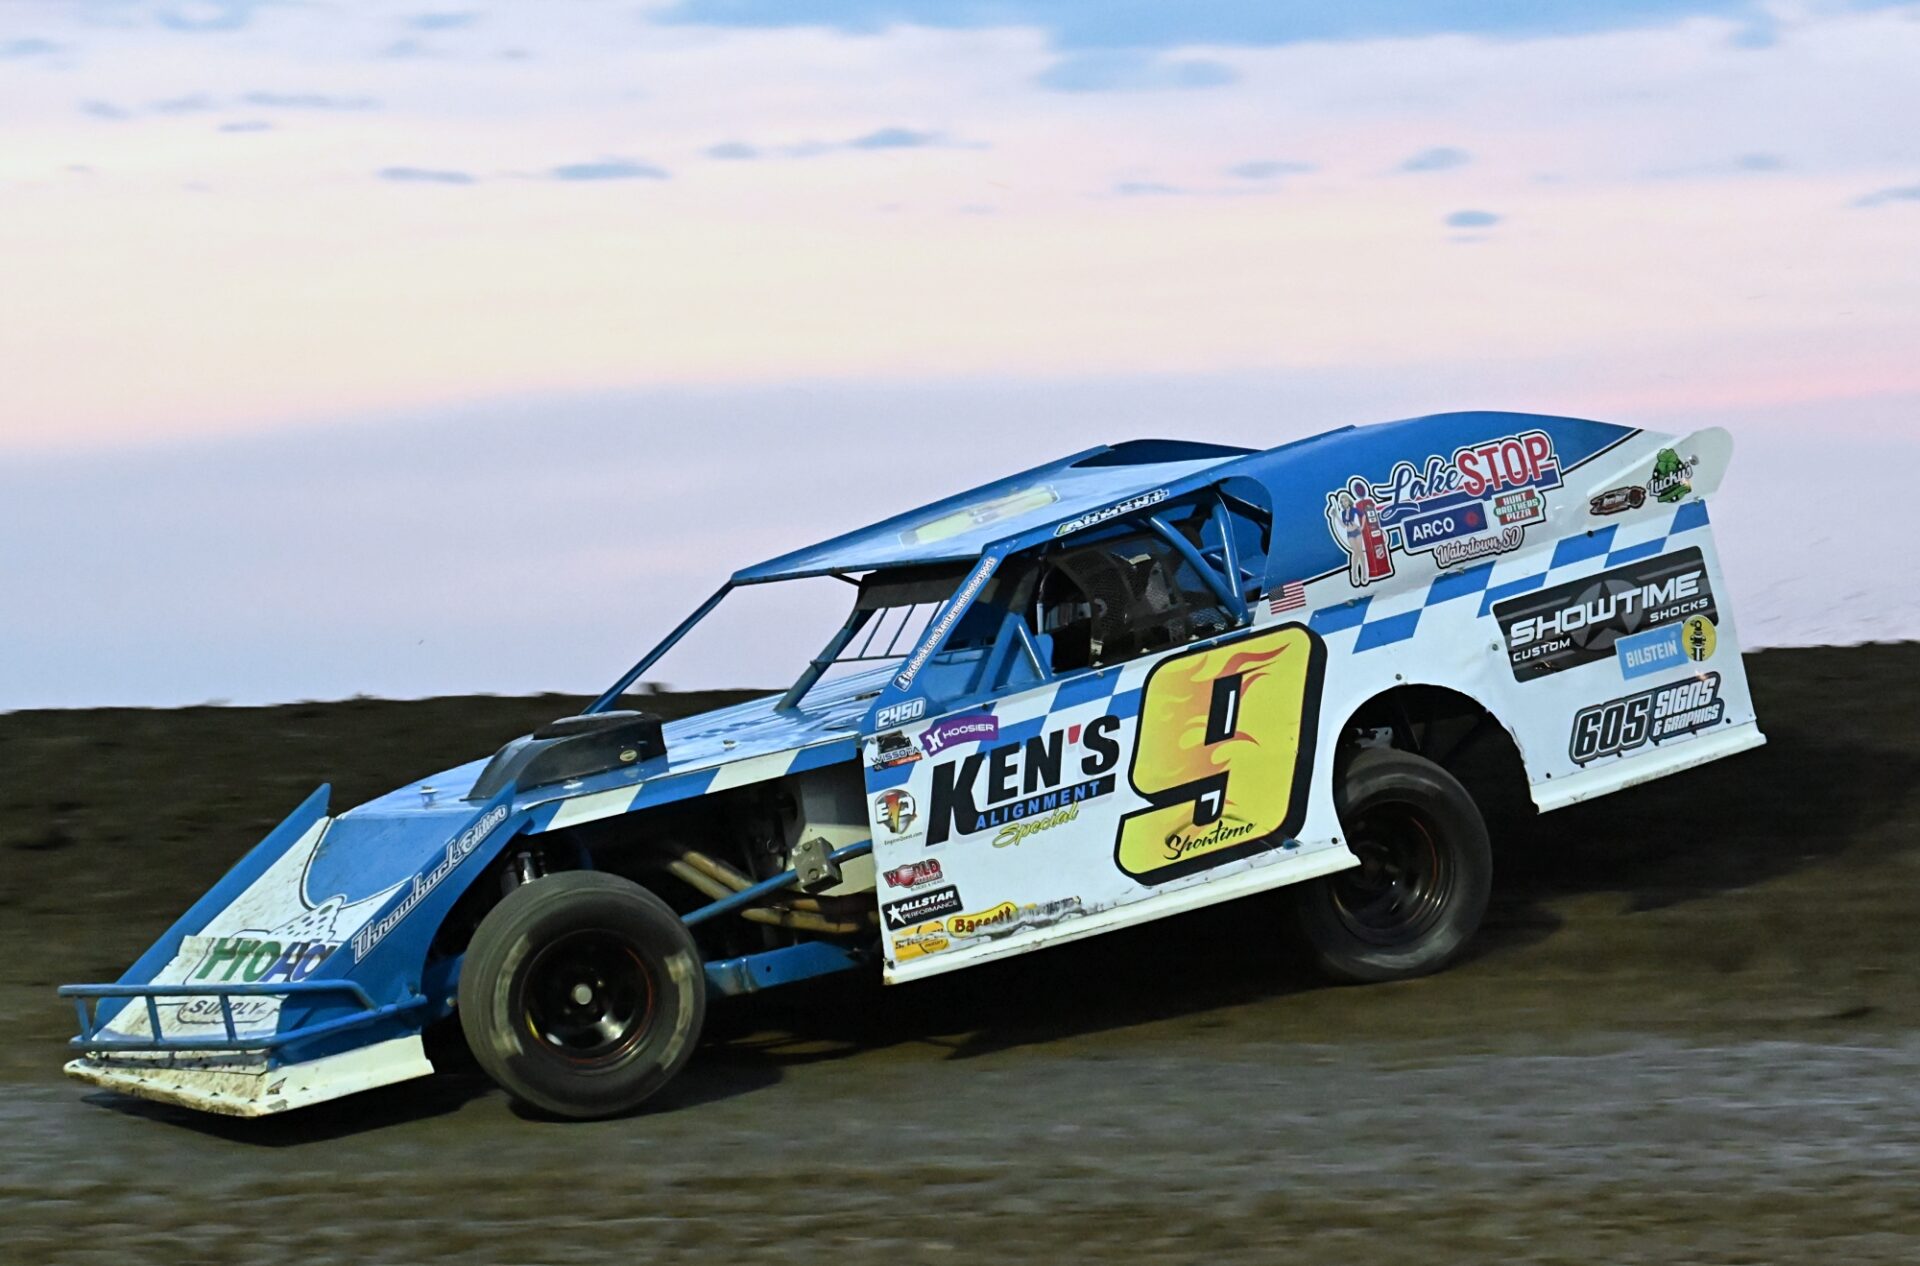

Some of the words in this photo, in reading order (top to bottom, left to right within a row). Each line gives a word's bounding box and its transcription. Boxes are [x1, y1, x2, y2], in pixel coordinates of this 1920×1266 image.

[1375, 461, 1463, 520] Lake
[1457, 435, 1549, 497] STOP
[1647, 461, 1694, 497] Lucky's
[1495, 498, 1540, 517] BROTHERS
[1502, 492, 1527, 506] HUNT
[1412, 517, 1455, 541] ARCO
[1506, 508, 1532, 522] PIZZA
[1502, 527, 1521, 547] SD
[1511, 570, 1702, 648] SHOWTIME
[1650, 598, 1708, 623] SHOCKS
[1513, 638, 1571, 663] CUSTOM
[1626, 640, 1678, 669] BILSTEIN
[877, 699, 925, 728] 2450
[1573, 694, 1652, 760] 605
[1654, 676, 1718, 720] SIGNS
[1652, 721, 1662, 738] &
[1664, 703, 1720, 734] GRAPHICS
[943, 722, 995, 740] HOOSIER
[871, 746, 920, 763] WISSOTA
[1113, 620, 1329, 887] 9
[926, 714, 1121, 847] KEN'S
[974, 780, 1101, 831] ALIGNMENT
[992, 802, 1079, 849] Special
[351, 839, 462, 964] Throwback
[457, 804, 507, 857] Edition
[900, 891, 954, 912] ALLSTAR
[902, 902, 958, 919] PERFORMANCE
